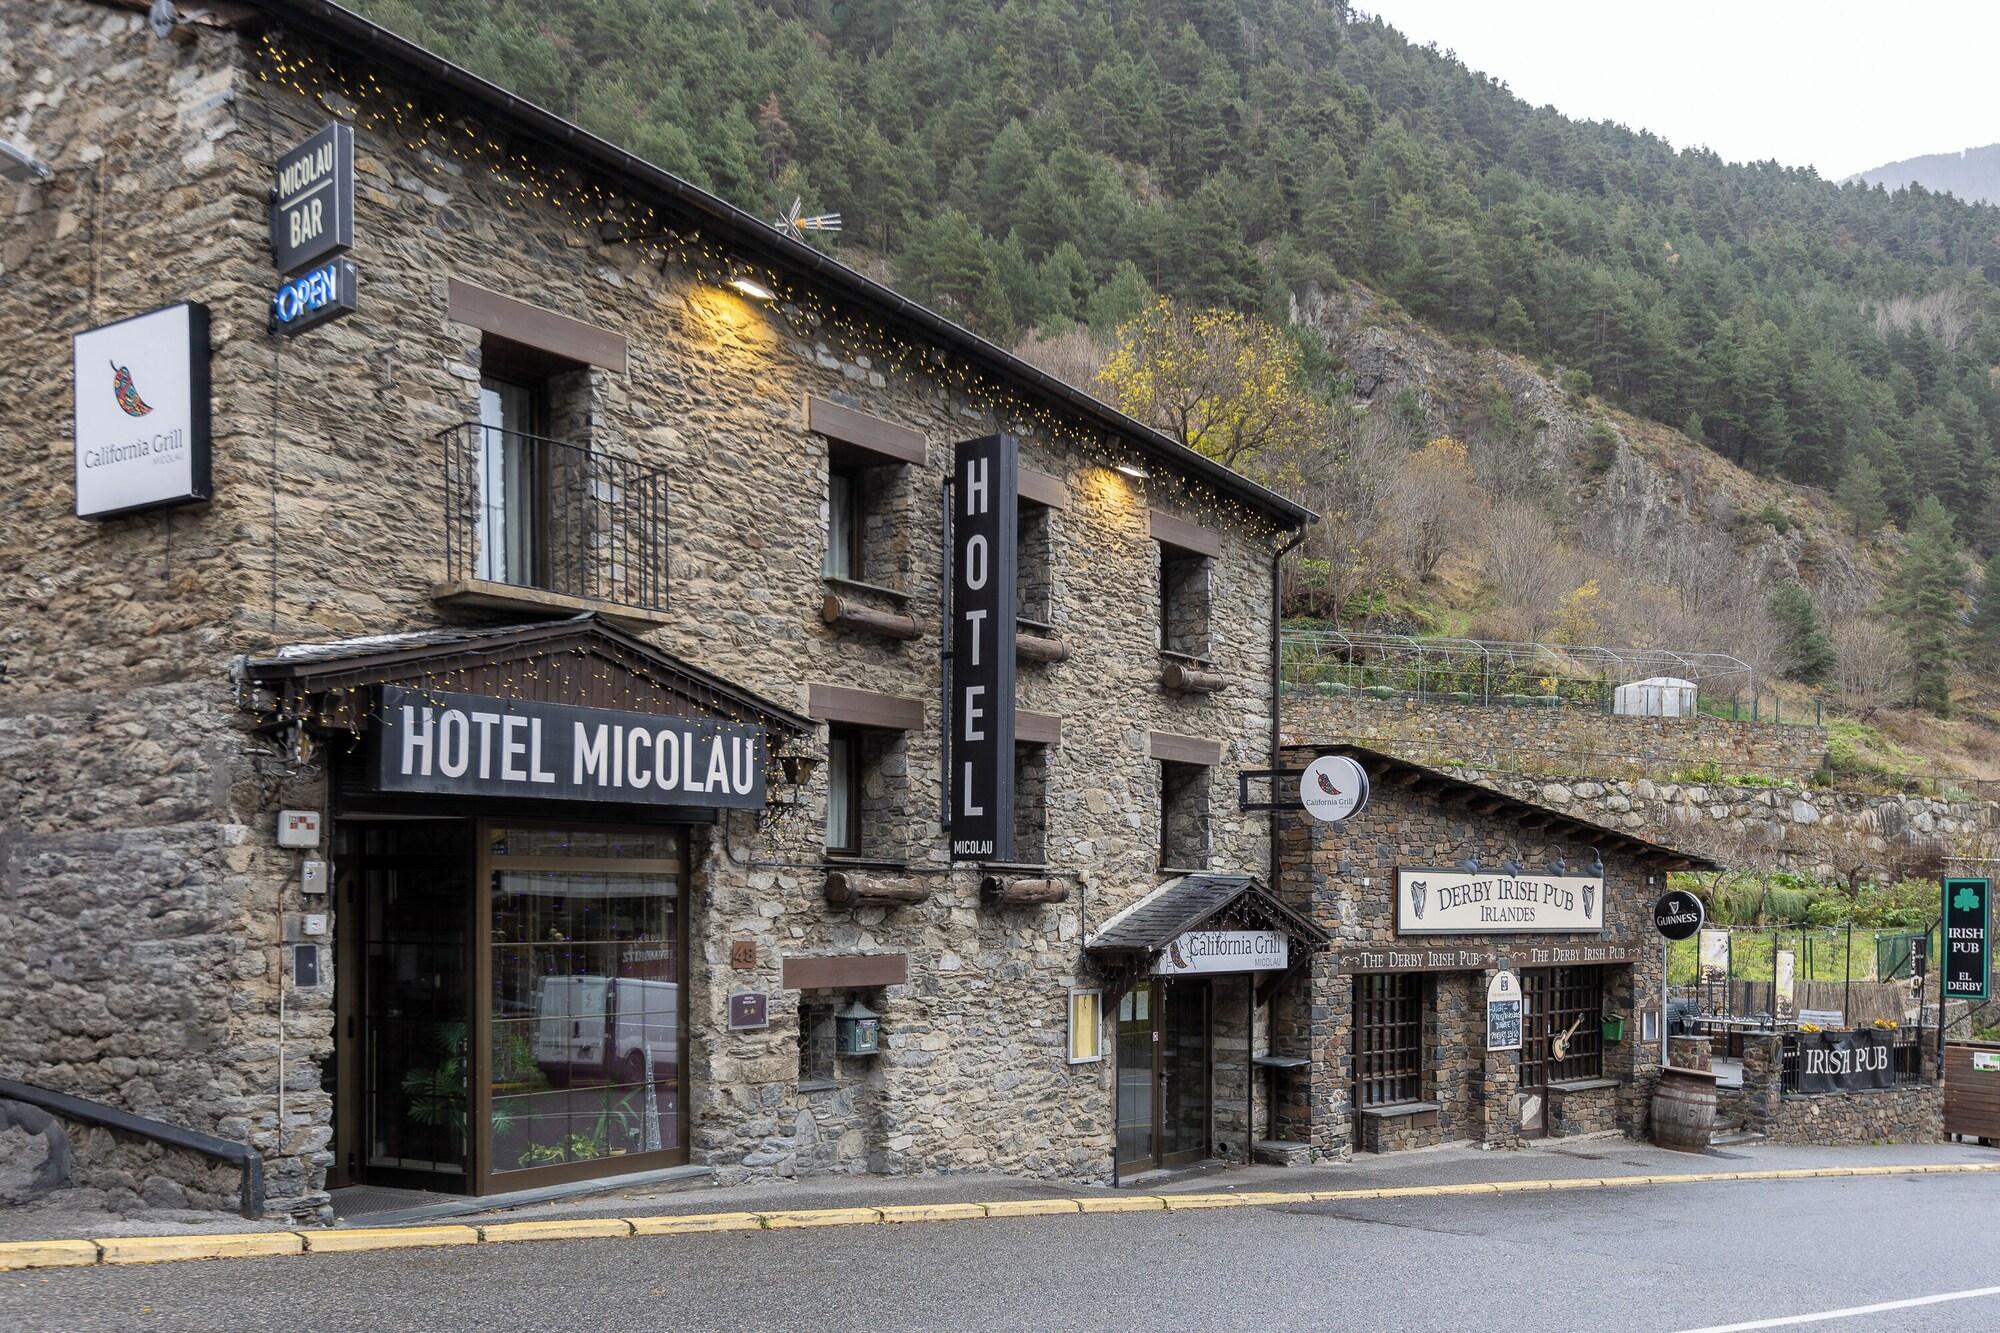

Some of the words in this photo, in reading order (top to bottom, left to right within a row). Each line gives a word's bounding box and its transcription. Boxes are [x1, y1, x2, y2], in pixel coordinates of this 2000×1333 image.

[279, 141, 333, 199] MICOLAU
[290, 198, 323, 249] BAR
[275, 265, 336, 322] OPEN
[84, 438, 149, 469] California
[153, 428, 183, 453] Grill
[964, 457, 988, 817] HOTEL
[400, 705, 556, 784] HOTEL
[573, 721, 754, 796] MICOLAU
[1306, 798, 1337, 806] California
[1339, 798, 1353, 806] Grill
[954, 840, 993, 855] MICOLAU
[1437, 880, 1493, 911] DERBY
[1497, 879, 1538, 901] IRISH
[1544, 883, 1574, 911] PUB
[1480, 905, 1536, 922] IRLANDES
[1656, 912, 1698, 926] GUINNESS
[1948, 927, 1984, 939] IRISH
[1190, 935, 1252, 956] California
[1255, 934, 1280, 954] Grill
[1531, 948, 1549, 962] THE
[1553, 947, 1580, 962] DERBY
[1584, 947, 1605, 960] IRISH
[1609, 946, 1625, 960] PUB
[1952, 942, 1980, 953] PUB
[1361, 952, 1384, 968] THE
[1389, 951, 1423, 968] DERBY
[1428, 951, 1455, 966] IRISH
[1459, 950, 1479, 966] PUB
[1959, 972, 1972, 981] EL
[1947, 981, 1983, 991] DERBY
[1805, 1048, 1851, 1075] IRISH
[1855, 1045, 1888, 1073] PUB
